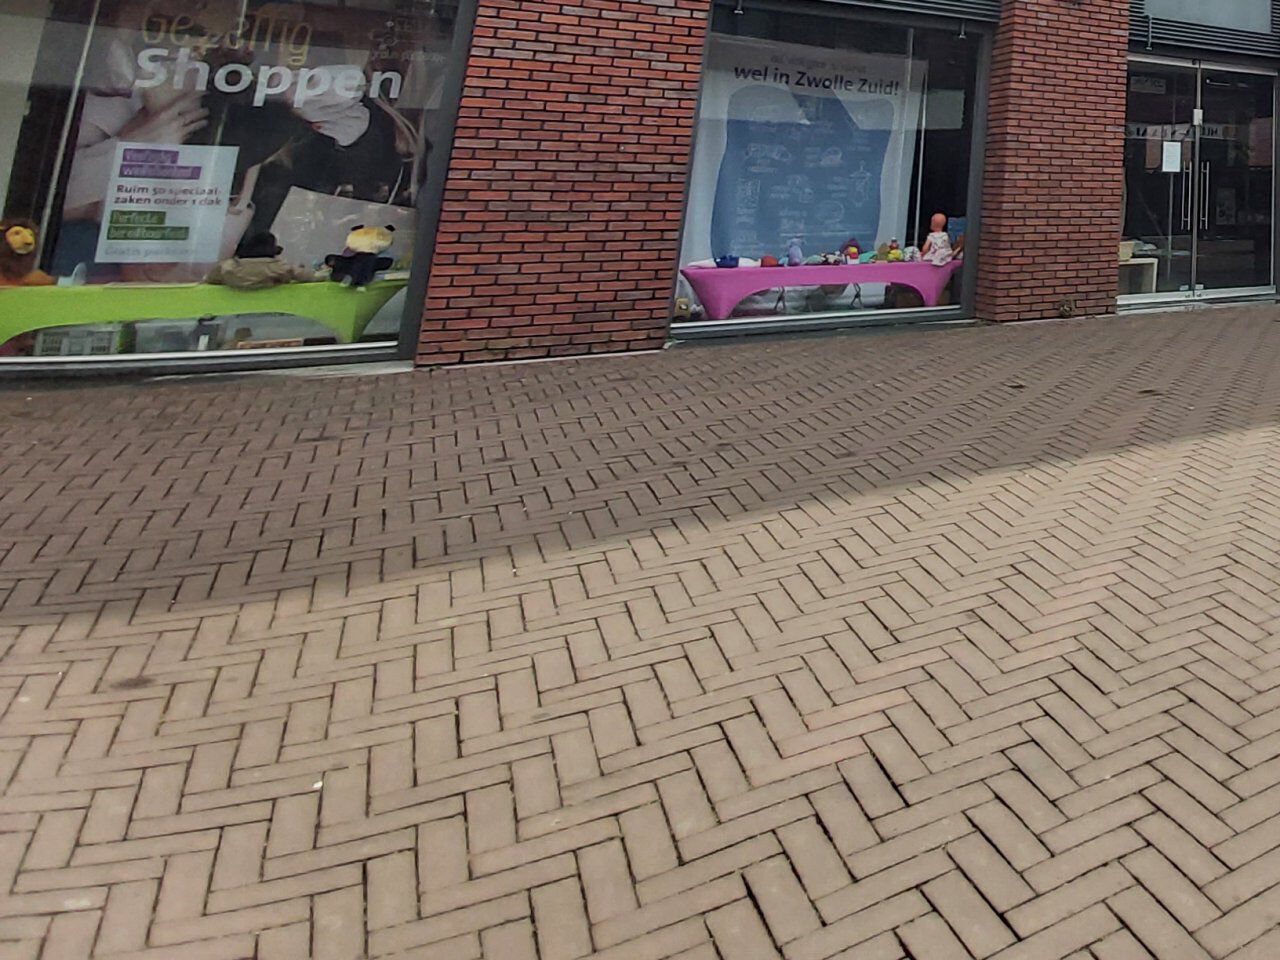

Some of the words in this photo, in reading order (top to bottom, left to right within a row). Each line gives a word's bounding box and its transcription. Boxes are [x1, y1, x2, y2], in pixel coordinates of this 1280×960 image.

[134, 46, 402, 108] Shoppen
[734, 66, 769, 81] wel
[773, 67, 790, 85] in
[794, 71, 853, 90] Zwolle
[857, 78, 899, 96] Zuid!
[116, 184, 149, 194] Ruim
[113, 195, 152, 205] zaken
[154, 195, 188, 206] onder
